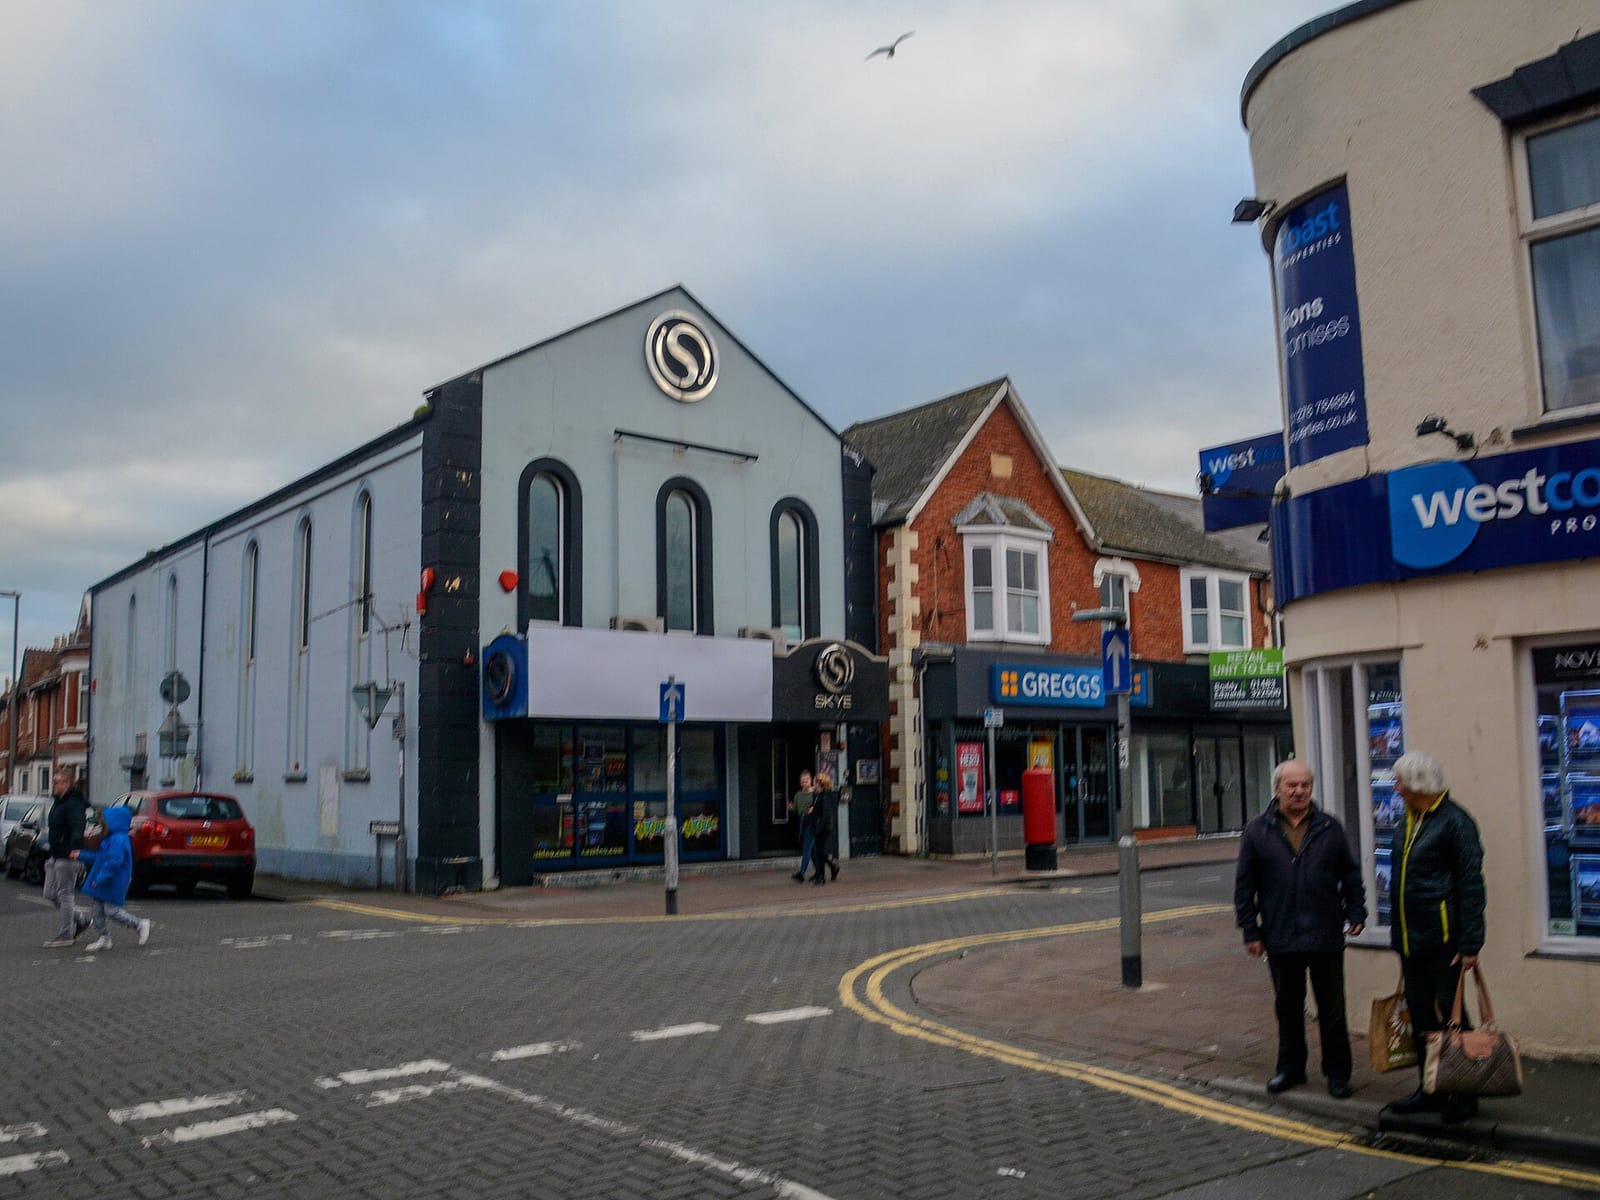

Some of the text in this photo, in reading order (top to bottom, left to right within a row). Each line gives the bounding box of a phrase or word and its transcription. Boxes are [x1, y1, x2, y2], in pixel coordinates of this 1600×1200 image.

[1551, 514, 1597, 536] PRO
[1226, 651, 1264, 665] RETAIL
[1213, 661, 1281, 677] UNIT TO LET
[1022, 671, 1101, 700] GREGGS
[815, 694, 853, 709] SKYE
